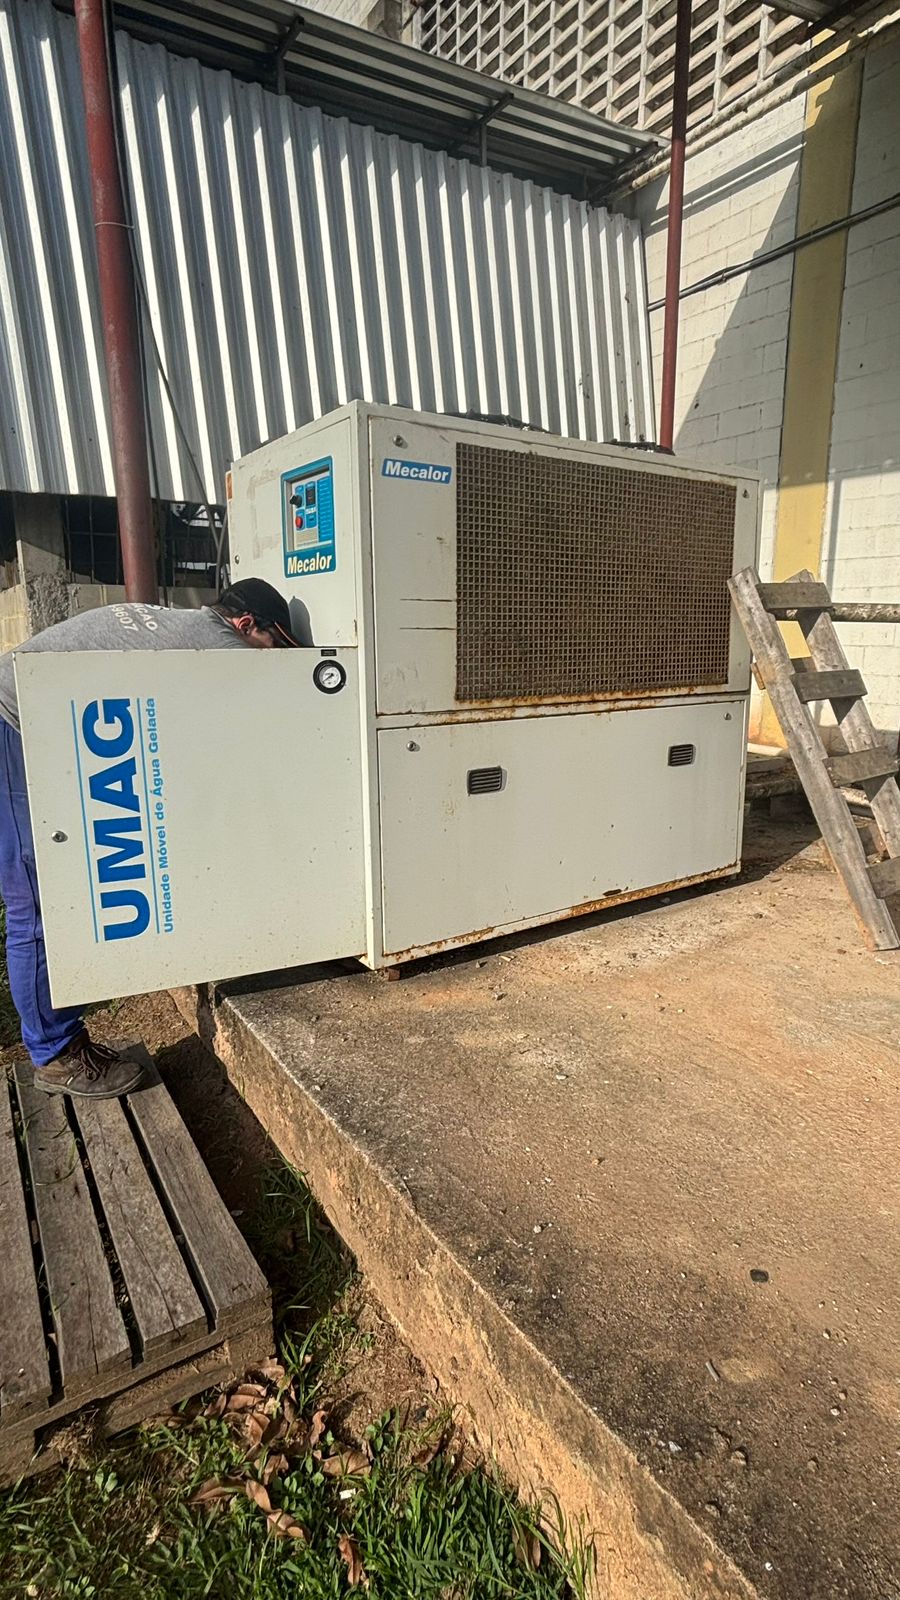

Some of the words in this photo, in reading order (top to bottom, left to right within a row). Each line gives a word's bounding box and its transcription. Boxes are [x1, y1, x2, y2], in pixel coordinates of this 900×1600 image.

[385, 460, 449, 481] Mecalor
[287, 552, 333, 575] Mecalor
[146, 698, 159, 754] Gelada
[150, 758, 164, 797] Água
[82, 698, 151, 941] UMAG
[154, 802, 165, 820] de
[156, 825, 169, 869] Móvel
[160, 874, 174, 933] Unidade
